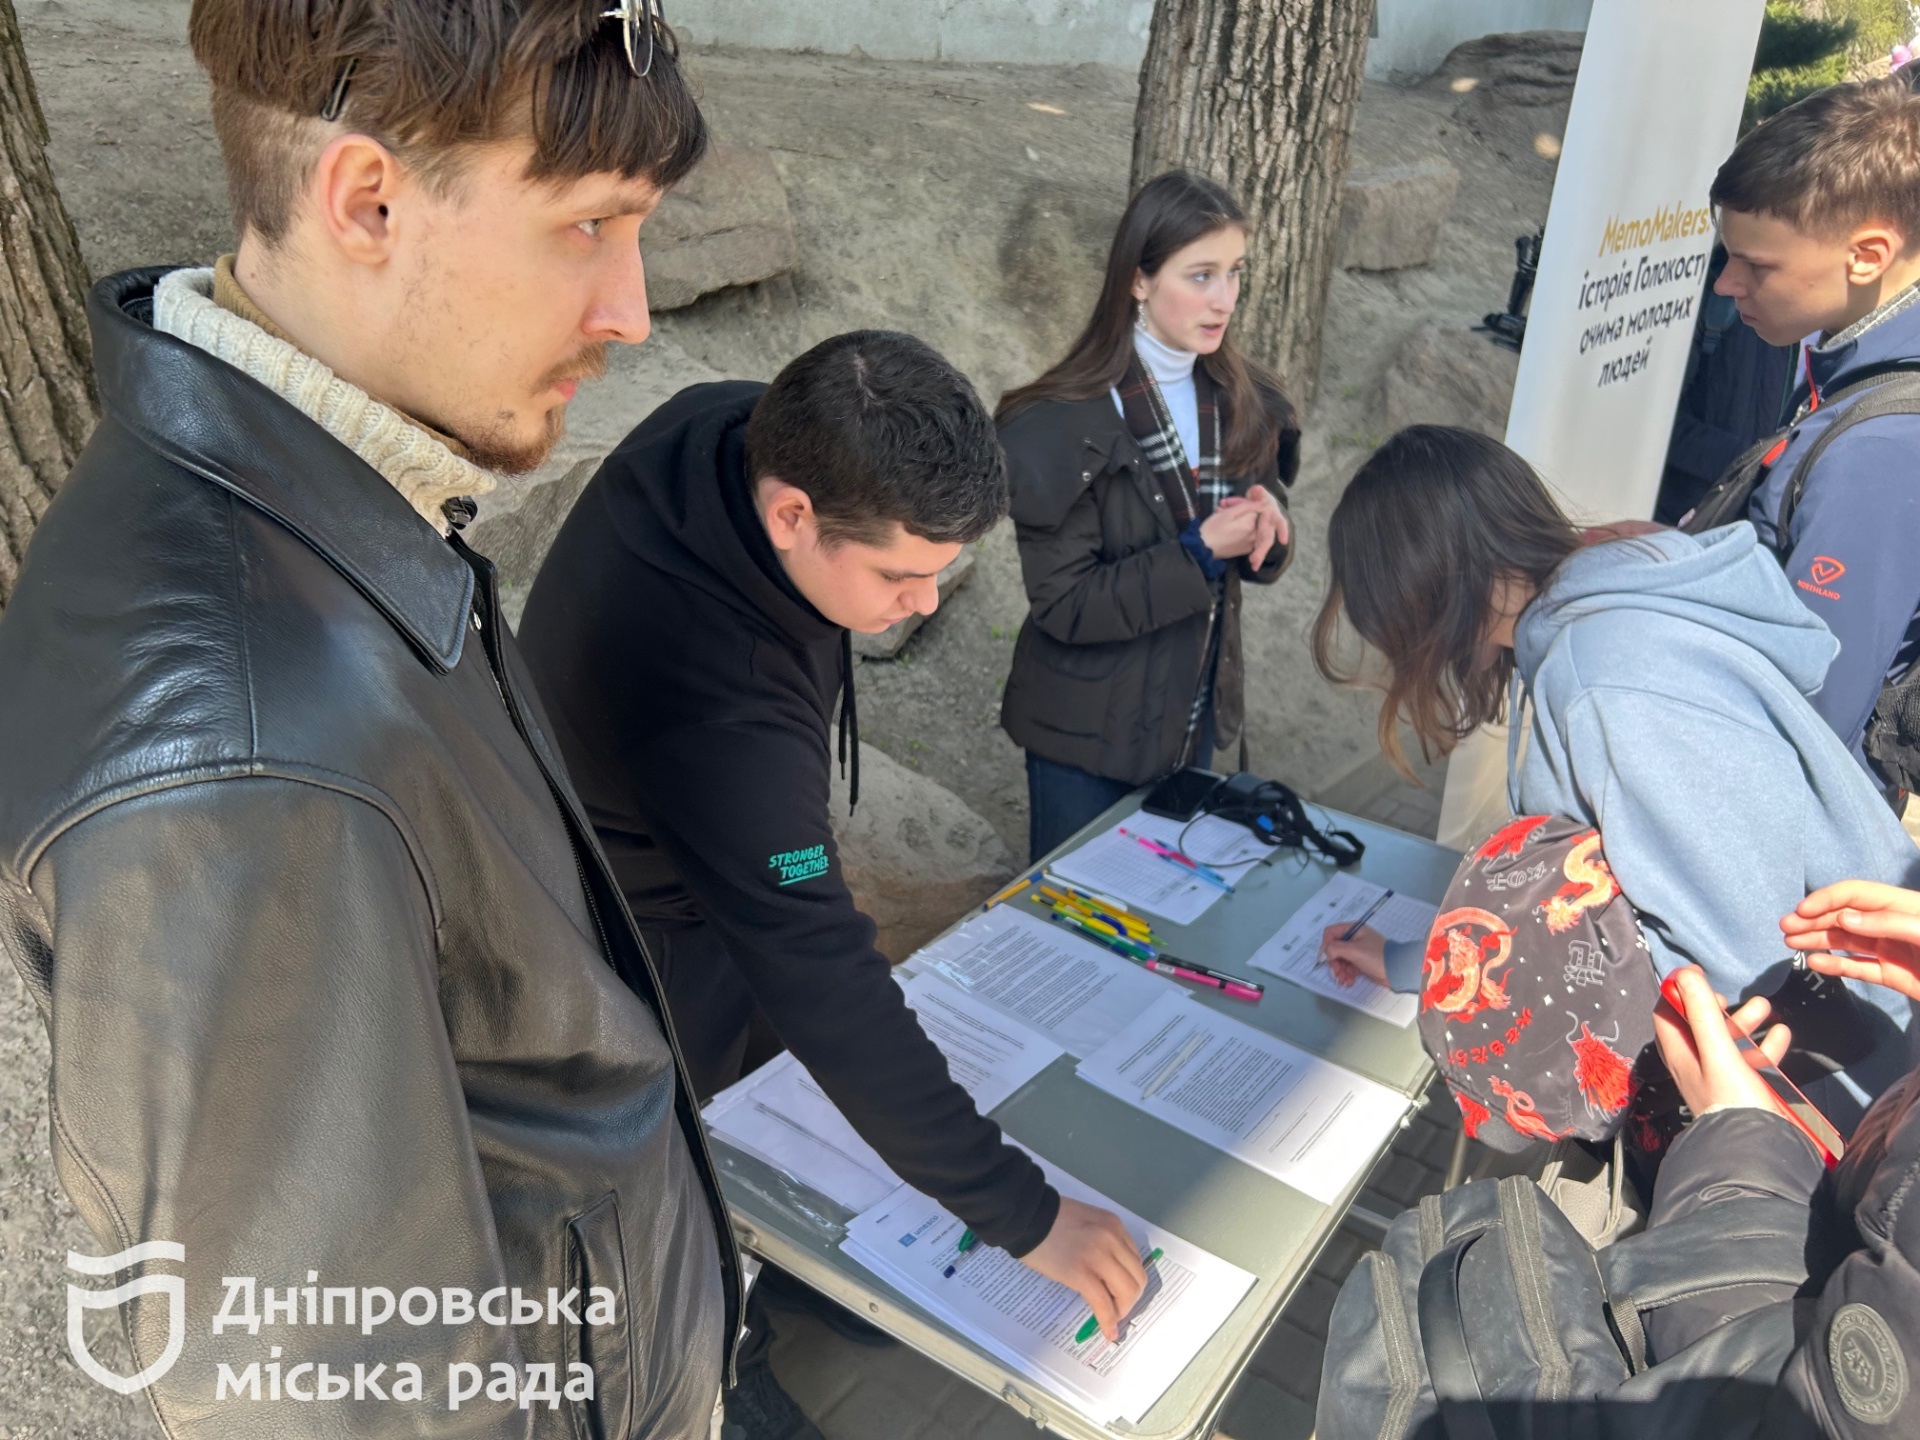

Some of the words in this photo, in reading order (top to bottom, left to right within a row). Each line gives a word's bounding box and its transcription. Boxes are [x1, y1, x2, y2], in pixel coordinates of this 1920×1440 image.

[1578, 259, 1633, 312] історія
[1579, 315, 1624, 355] очима
[1625, 296, 1694, 337] молодих
[1598, 335, 1652, 388] людей
[768, 844, 825, 868] STRONGER
[780, 855, 829, 879] TOGETHER
